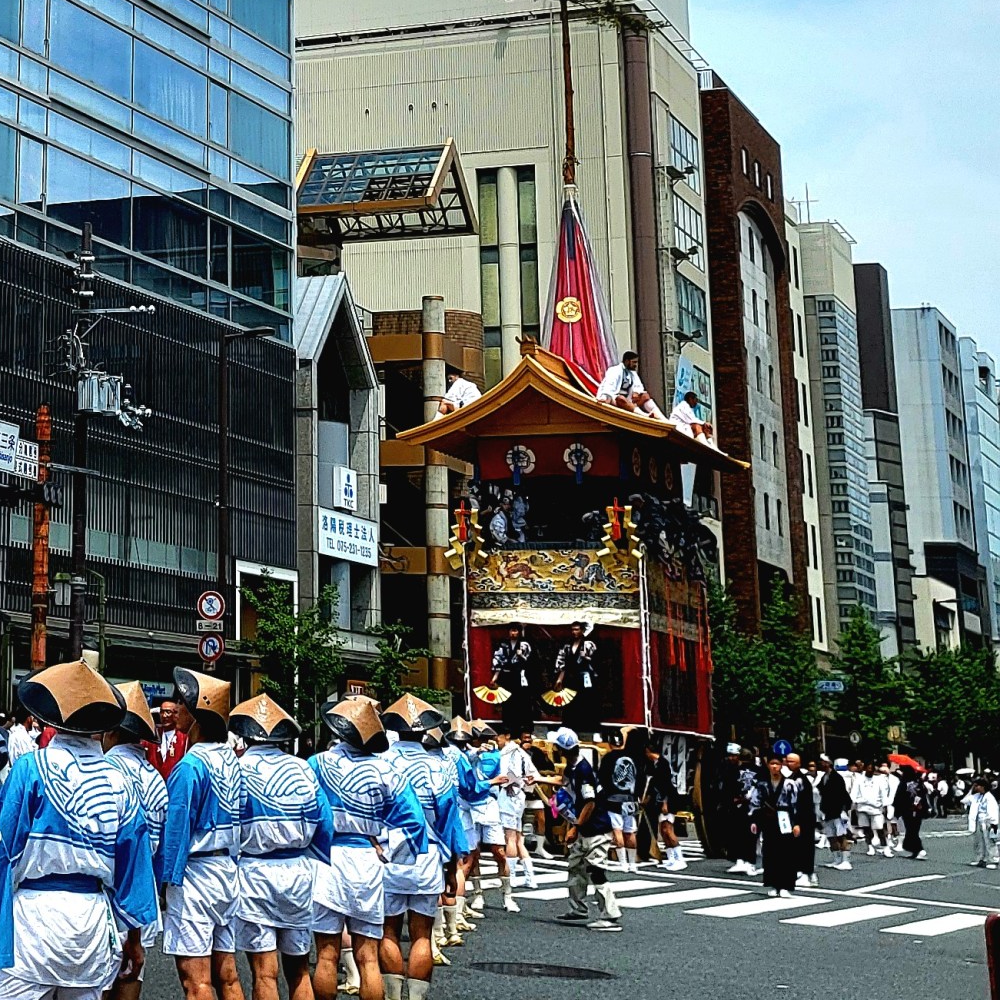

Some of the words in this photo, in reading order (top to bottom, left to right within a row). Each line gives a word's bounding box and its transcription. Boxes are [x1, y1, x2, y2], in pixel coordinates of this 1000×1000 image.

[343, 498, 354, 508] TKC
[322, 514, 375, 543] 洛陽税理士法人
[326, 536, 335, 549] TEL
